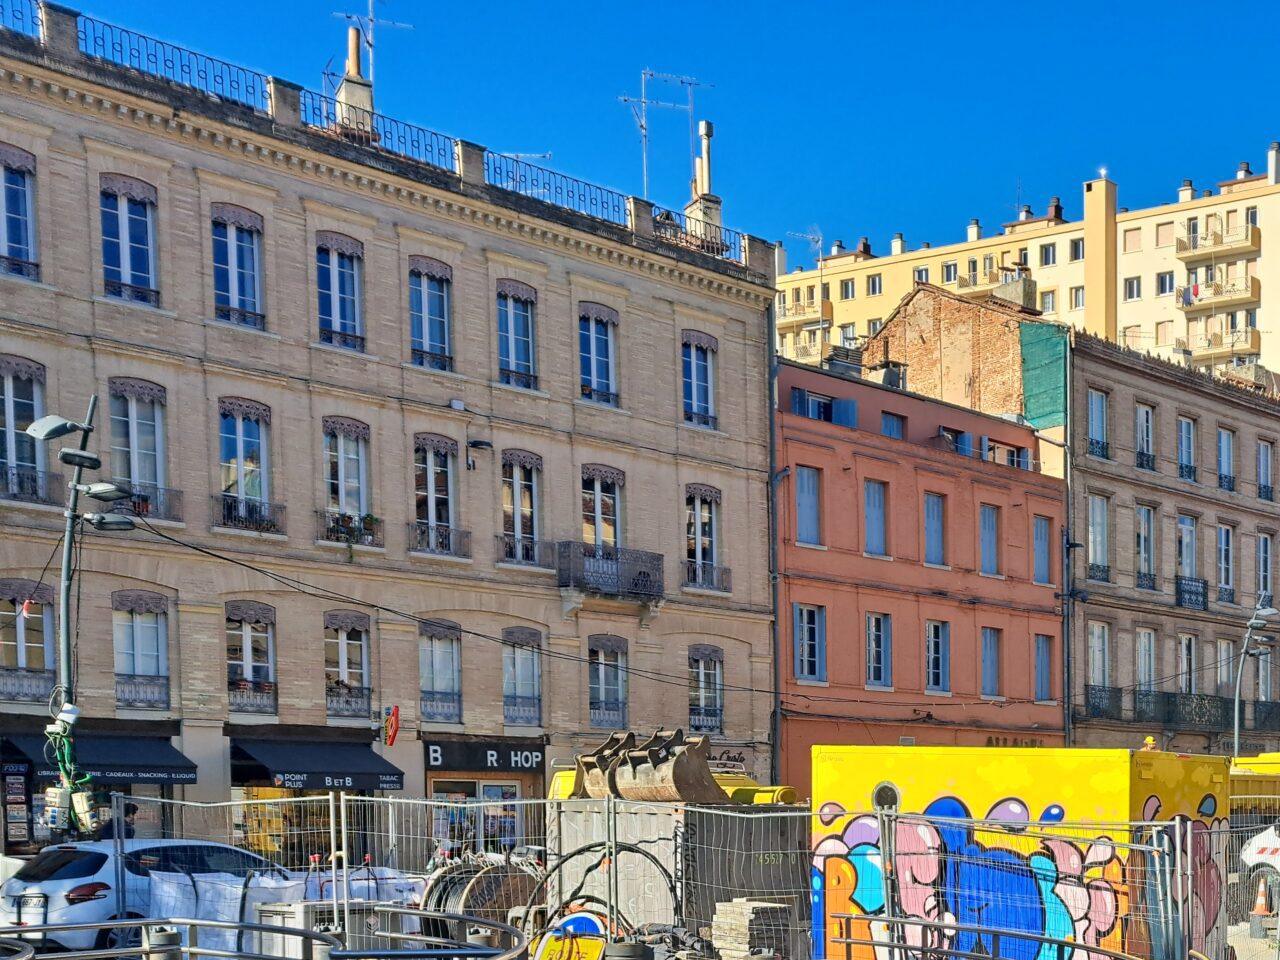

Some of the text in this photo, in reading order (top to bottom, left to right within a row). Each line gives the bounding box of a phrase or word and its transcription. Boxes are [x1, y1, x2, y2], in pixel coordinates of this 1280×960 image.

[429, 745, 542, 768] B R HOP
[284, 773, 308, 782] POINT
[325, 776, 333, 787] B
[345, 777, 353, 788] B
[285, 781, 304, 789] PLUS
[379, 782, 402, 790] PRESSE
